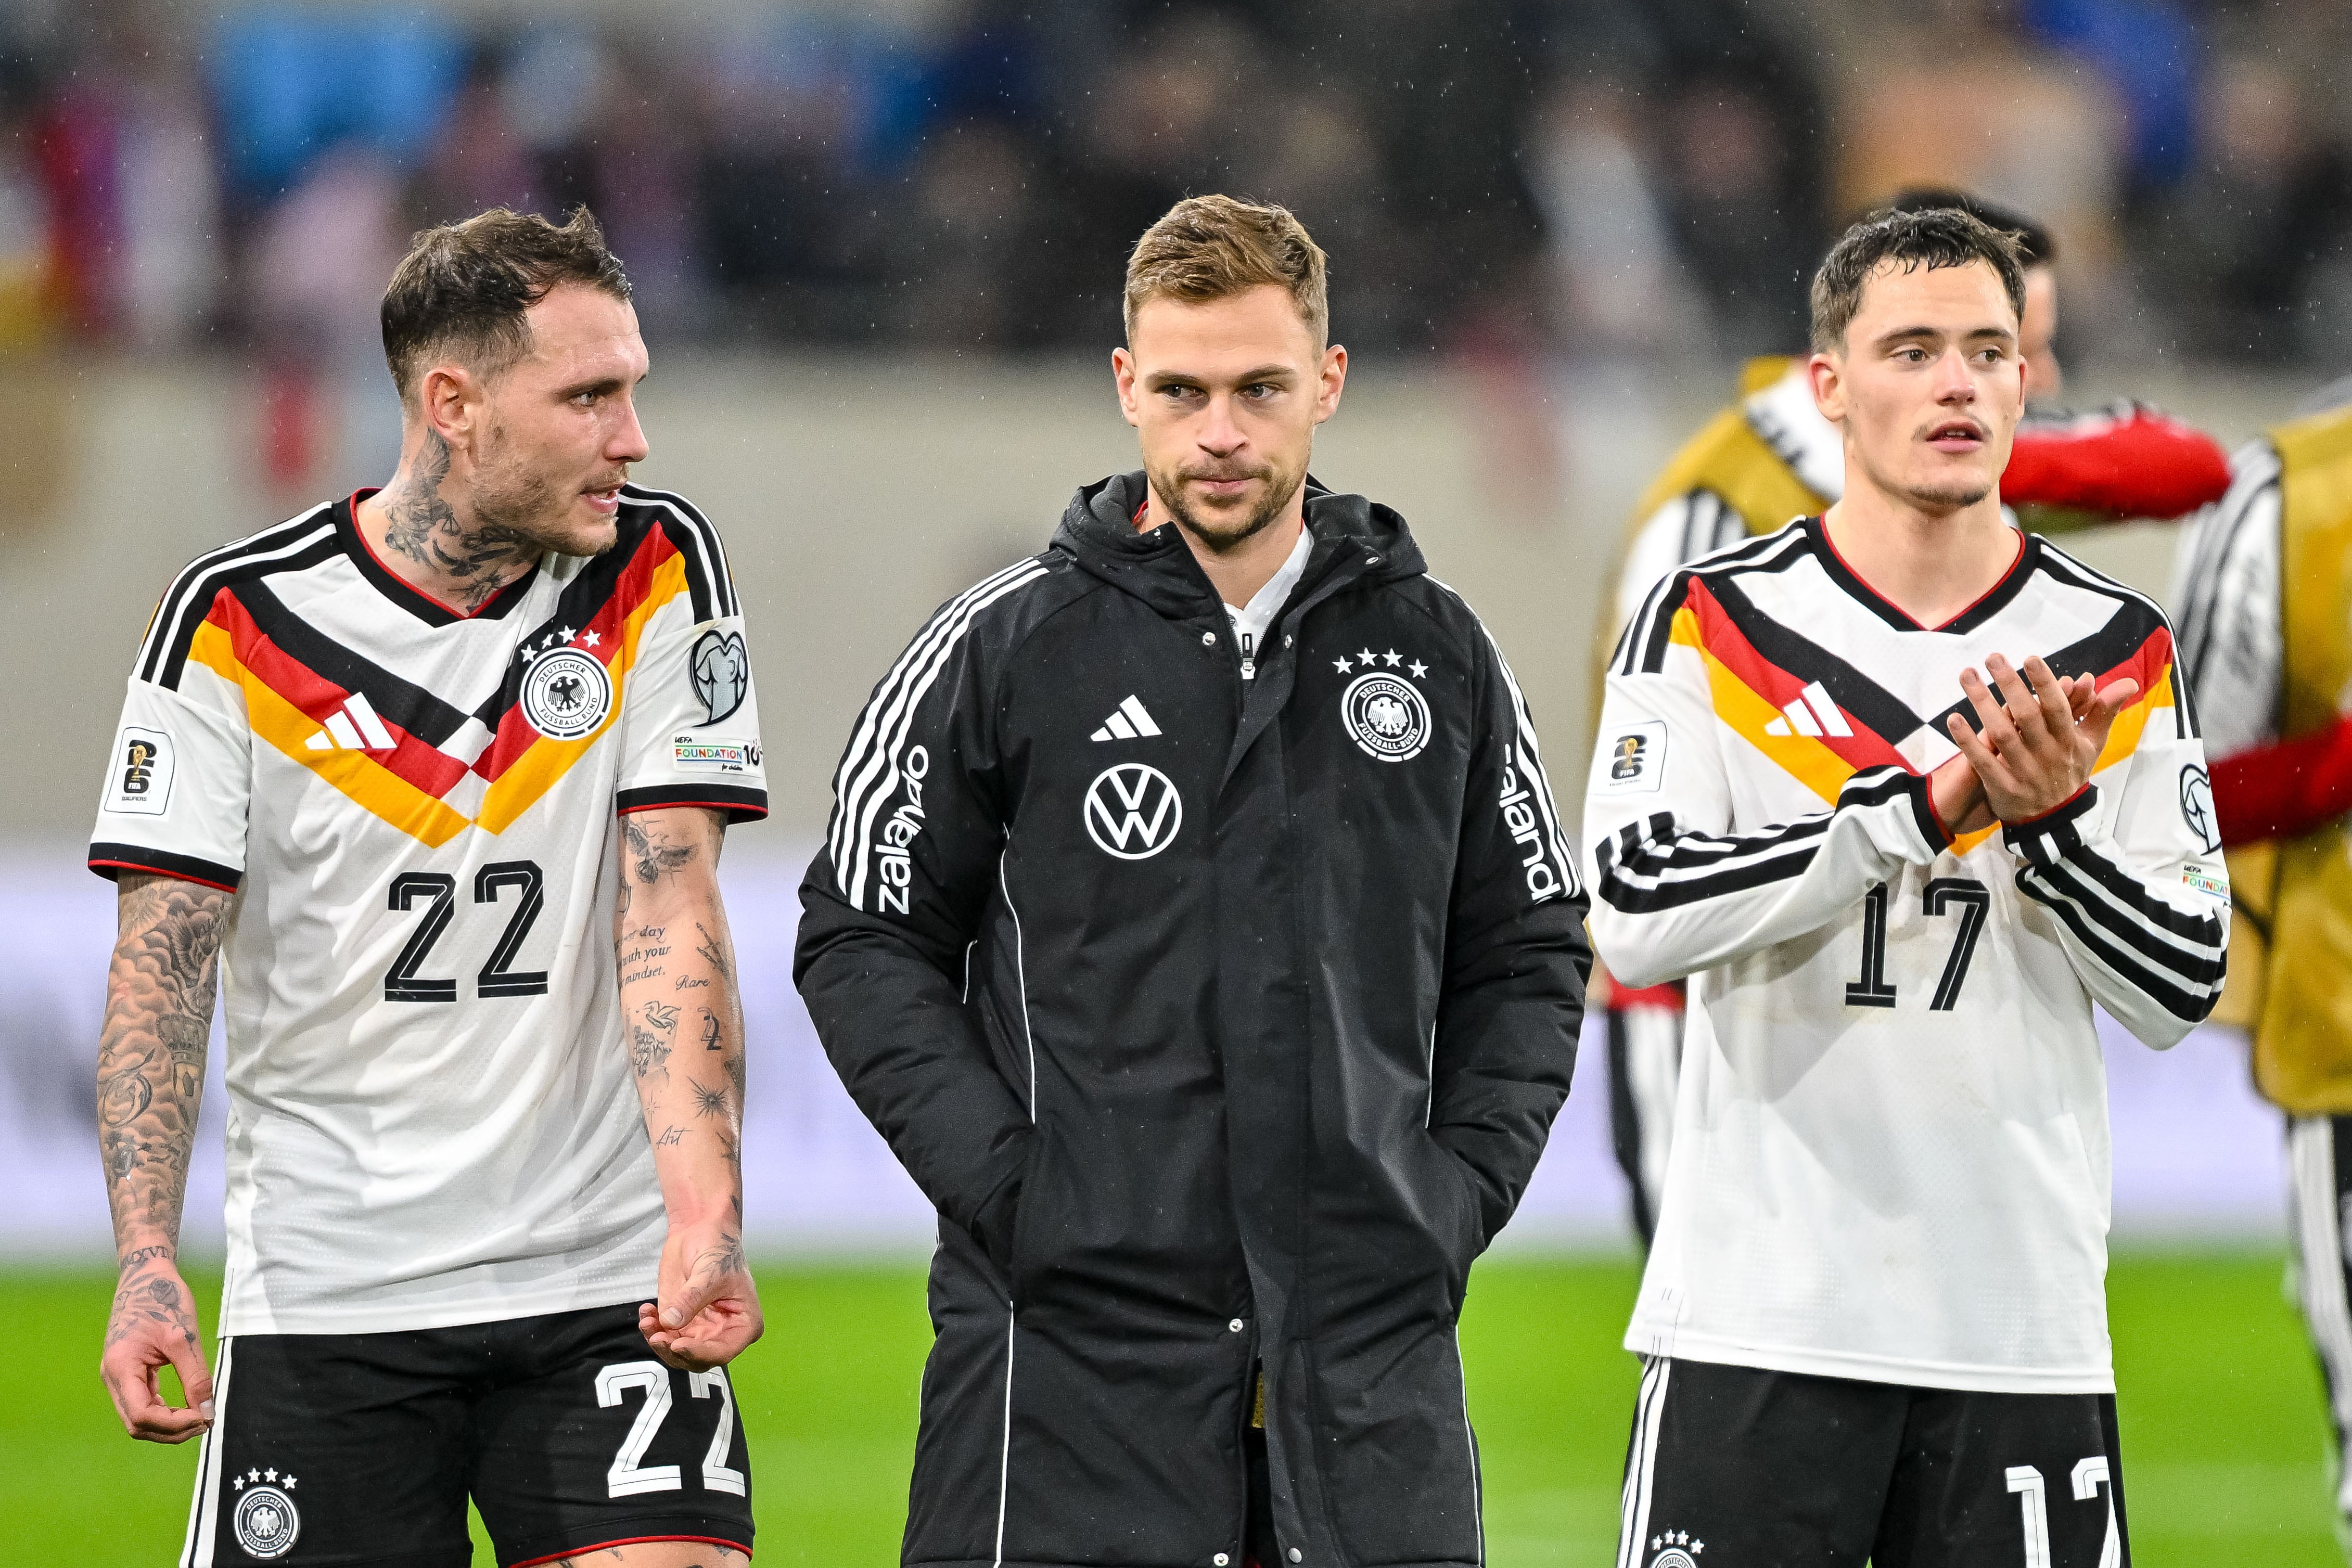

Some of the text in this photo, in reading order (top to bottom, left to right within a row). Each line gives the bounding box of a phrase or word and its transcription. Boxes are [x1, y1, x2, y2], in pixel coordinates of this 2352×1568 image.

[539, 662, 586, 683] DEUTSCHER
[1359, 683, 1410, 702] DEUTSCHER
[540, 697, 597, 726] FUSSBALL-BUND
[1358, 722, 1418, 750] FUSSBALL-BUND
[1086, 765, 1180, 857] VW
[875, 744, 929, 915] zalando
[1499, 743, 1561, 906] aland
[2183, 876, 2230, 897] FOUNDATI
[385, 859, 548, 1002] 22
[640, 925, 666, 943] day
[644, 946, 672, 962] your
[1845, 875, 1990, 1011] 17
[676, 974, 710, 990] Rare
[656, 1125, 694, 1149] Art
[595, 1360, 746, 1498] 22
[246, 1496, 282, 1510] DEUTSCHER
[244, 1528, 288, 1548] FUSSBALL-BUND
